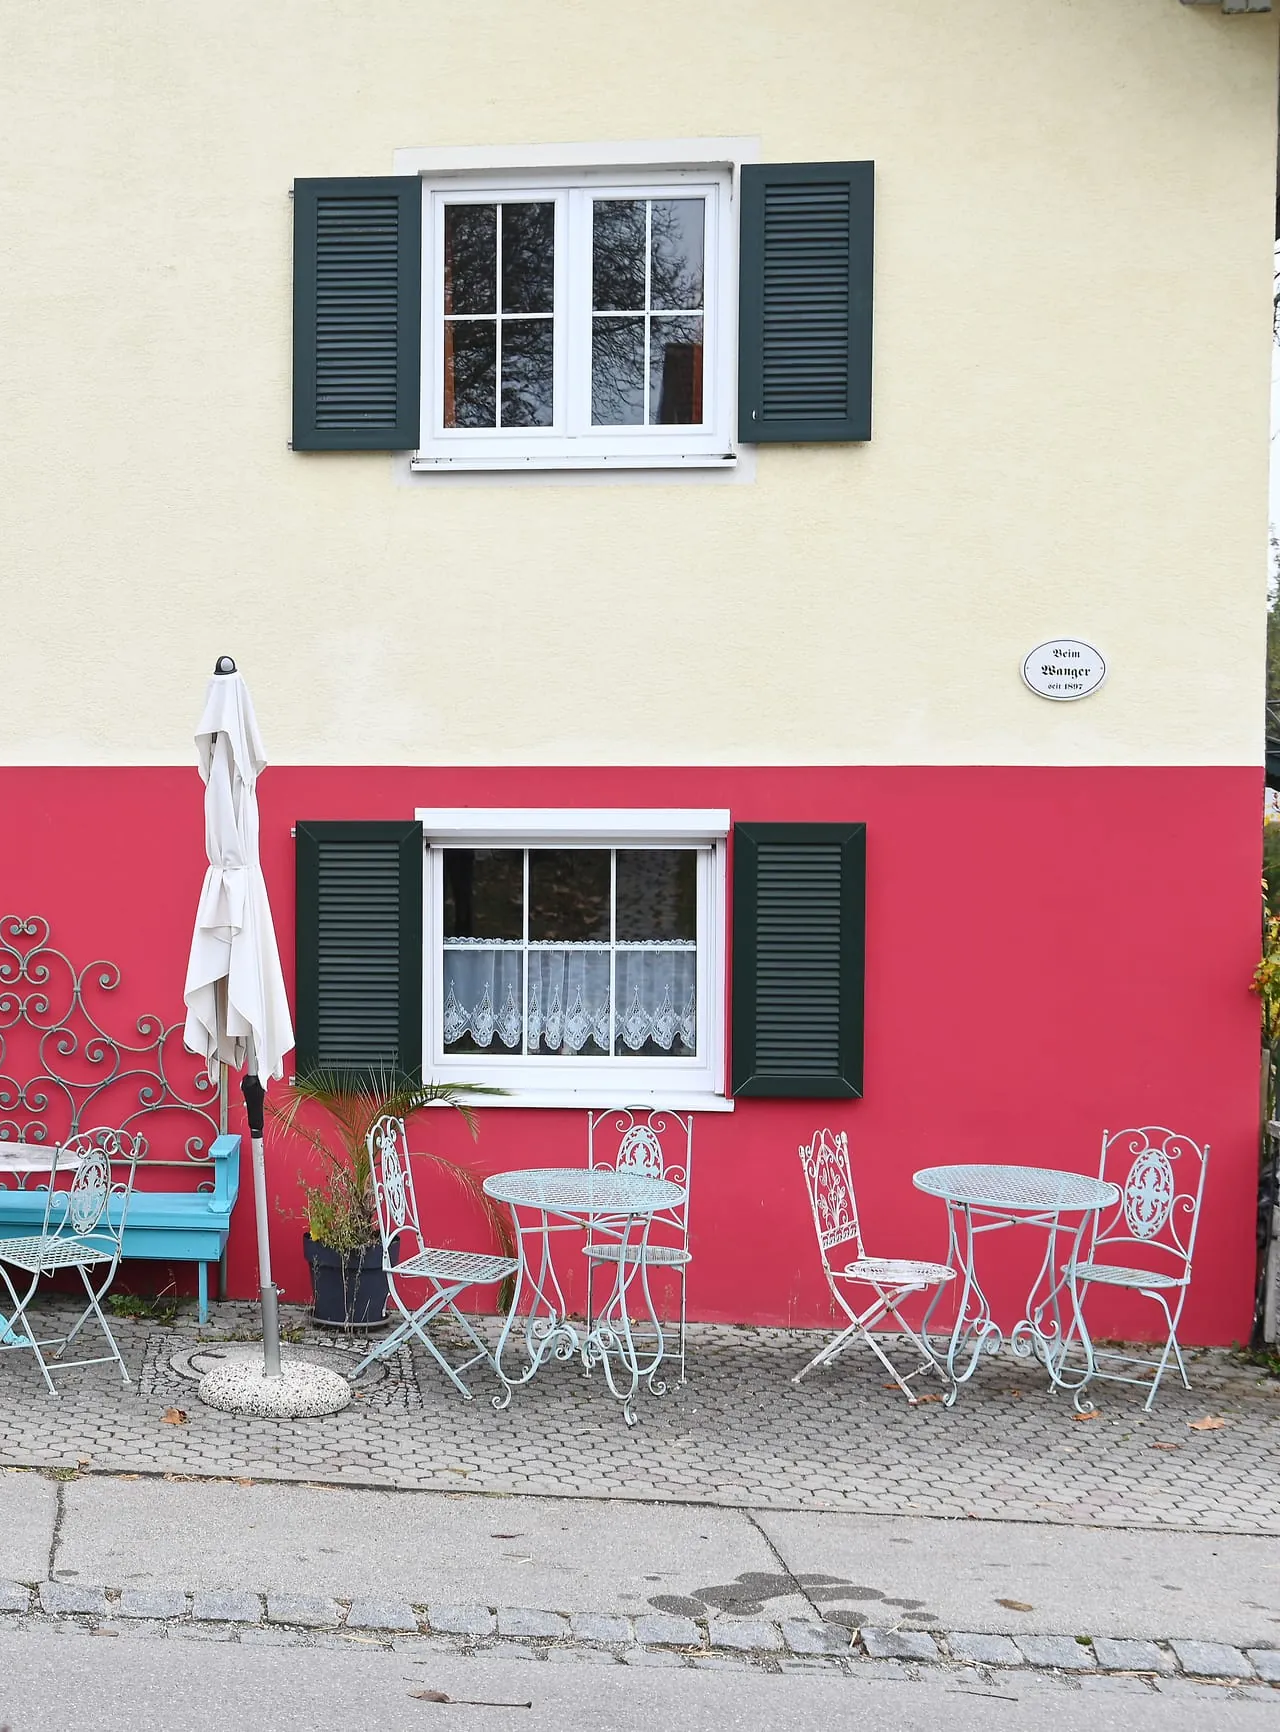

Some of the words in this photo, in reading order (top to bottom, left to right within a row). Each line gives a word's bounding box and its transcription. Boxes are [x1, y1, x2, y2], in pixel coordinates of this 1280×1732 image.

[1052, 648, 1081, 658] Beim
[1041, 664, 1091, 679] Wanger
[1047, 682, 1062, 690] seit
